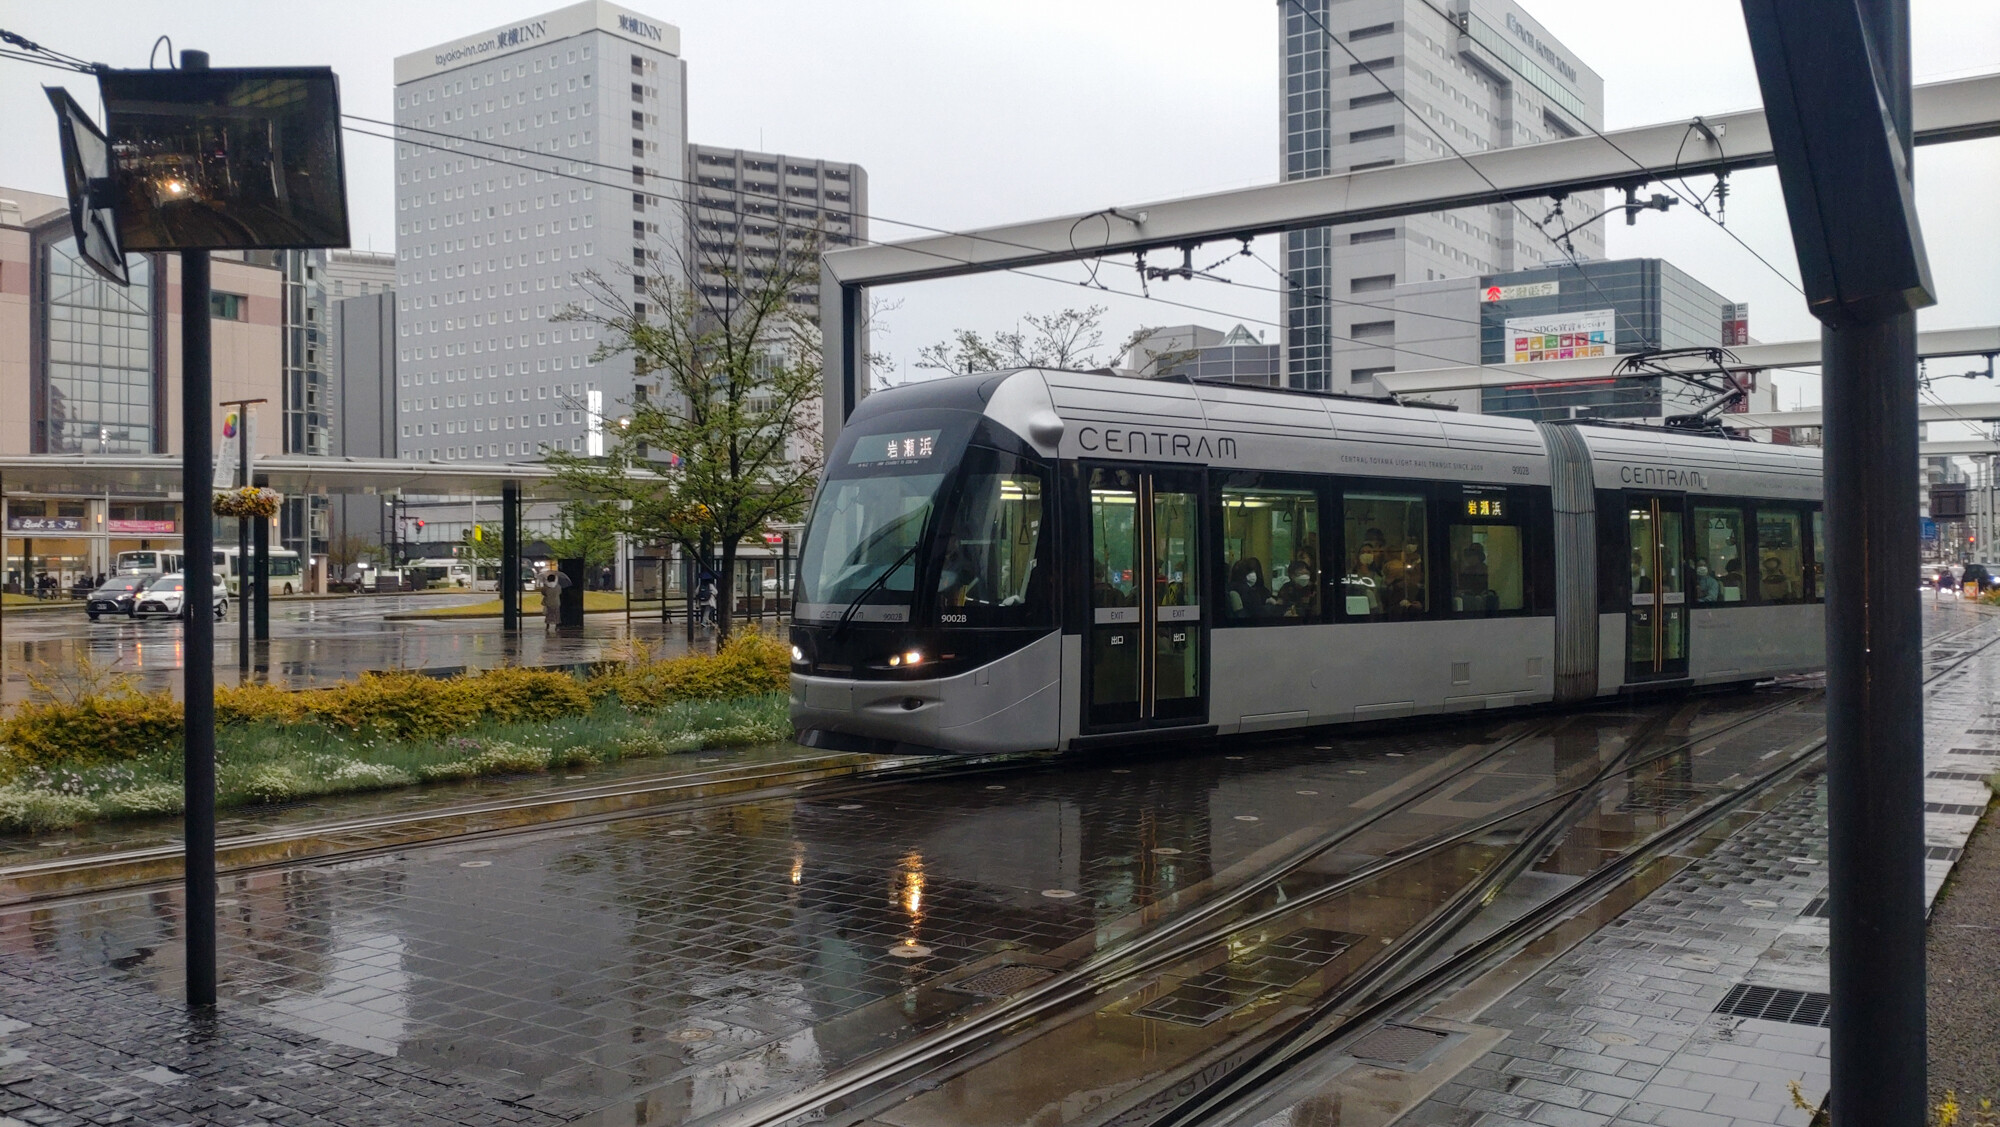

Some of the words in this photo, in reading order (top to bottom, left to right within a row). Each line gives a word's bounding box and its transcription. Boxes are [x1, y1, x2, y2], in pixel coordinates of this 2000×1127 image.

[618, 14, 662, 42] 東横INN
[435, 40, 496, 66] toyoko-inn.com
[497, 20, 548, 50] 東横INN
[887, 436, 933, 459] 岩瀬浜
[1078, 426, 1237, 460] CENTRAM
[1341, 455, 1368, 465] CENTRAL
[1369, 457, 1393, 466] TOYAMA
[1395, 458, 1412, 467] LIGHT
[1414, 459, 1427, 468] RAIL
[1428, 460, 1452, 469] TRANSIT
[1453, 462, 1469, 471] SINCE
[1620, 465, 1701, 488] CENTRAM
[1467, 500, 1502, 516] 岩瀬浜
[819, 610, 864, 620] CENTM
[941, 614, 967, 623] 9002B
[1111, 611, 1124, 620] EXIT
[1172, 609, 1185, 618] EXIT
[1111, 635, 1124, 645] 出口
[1173, 633, 1186, 642] 出口
